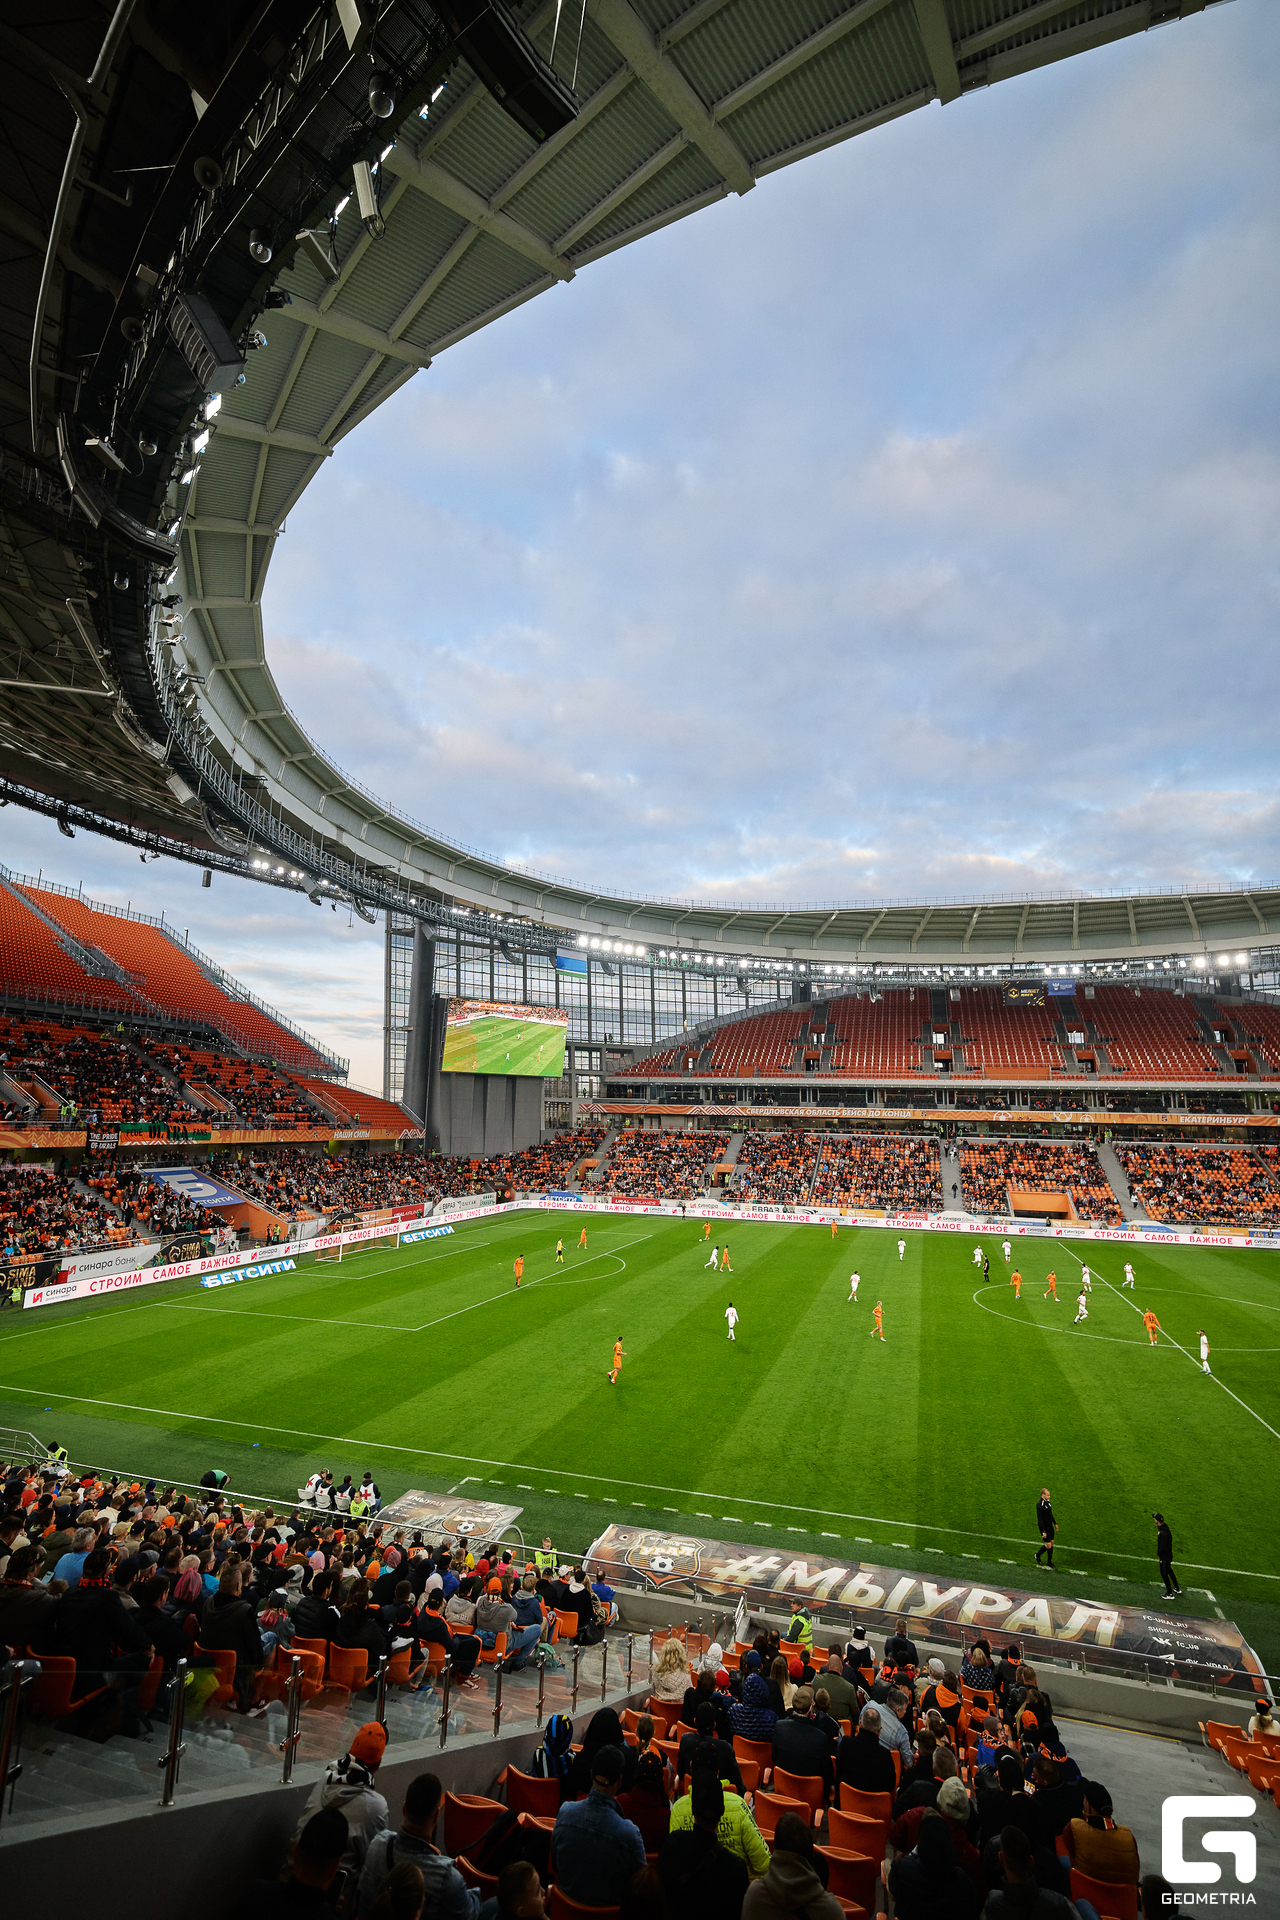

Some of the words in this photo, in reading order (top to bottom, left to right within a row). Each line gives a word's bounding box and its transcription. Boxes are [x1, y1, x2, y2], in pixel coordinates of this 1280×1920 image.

[842, 1108, 867, 1116] БЕЙСЯ
[882, 1110, 912, 1118] КОНЦА
[1180, 1116, 1249, 1124] ЕКАТЕРИНБУРГ
[334, 1131, 353, 1139] НАШИ
[353, 1130, 370, 1138] СИЛЫ
[776, 1214, 810, 1222] ВАЖНОЕ
[886, 1219, 922, 1227] СТРОИМ
[930, 1222, 961, 1230] САМОЕ
[970, 1225, 1008, 1233] ВАЖНОЕ
[348, 1230, 371, 1241] САМОЕ
[403, 1225, 455, 1243] БЕТСИТИ
[1094, 1231, 1135, 1239] СТРОИМ
[1144, 1233, 1180, 1241] САМОЕ
[1190, 1236, 1233, 1245] ВАЖНОЕ
[181, 1242, 200, 1251] SIMA
[180, 1250, 200, 1261] LAND
[78, 1260, 113, 1272] синара
[115, 1255, 137, 1266] банк
[8, 1266, 36, 1279] SIMA
[89, 1272, 142, 1292] СТРОИМ
[152, 1264, 191, 1280] САМОЕ
[200, 1255, 241, 1271] ВАЖНОЕ
[204, 1259, 296, 1288] БЕТСИТИ
[6, 1276, 36, 1290] LAND
[46, 1285, 77, 1297] синара
[639, 1545, 697, 1557] УРАЛ
[709, 1555, 1124, 1648] #МЫУРАЛ
[1142, 1614, 1188, 1629] FC-URAL.RU
[1147, 1626, 1217, 1643] SHOP.FC-URAL.RU
